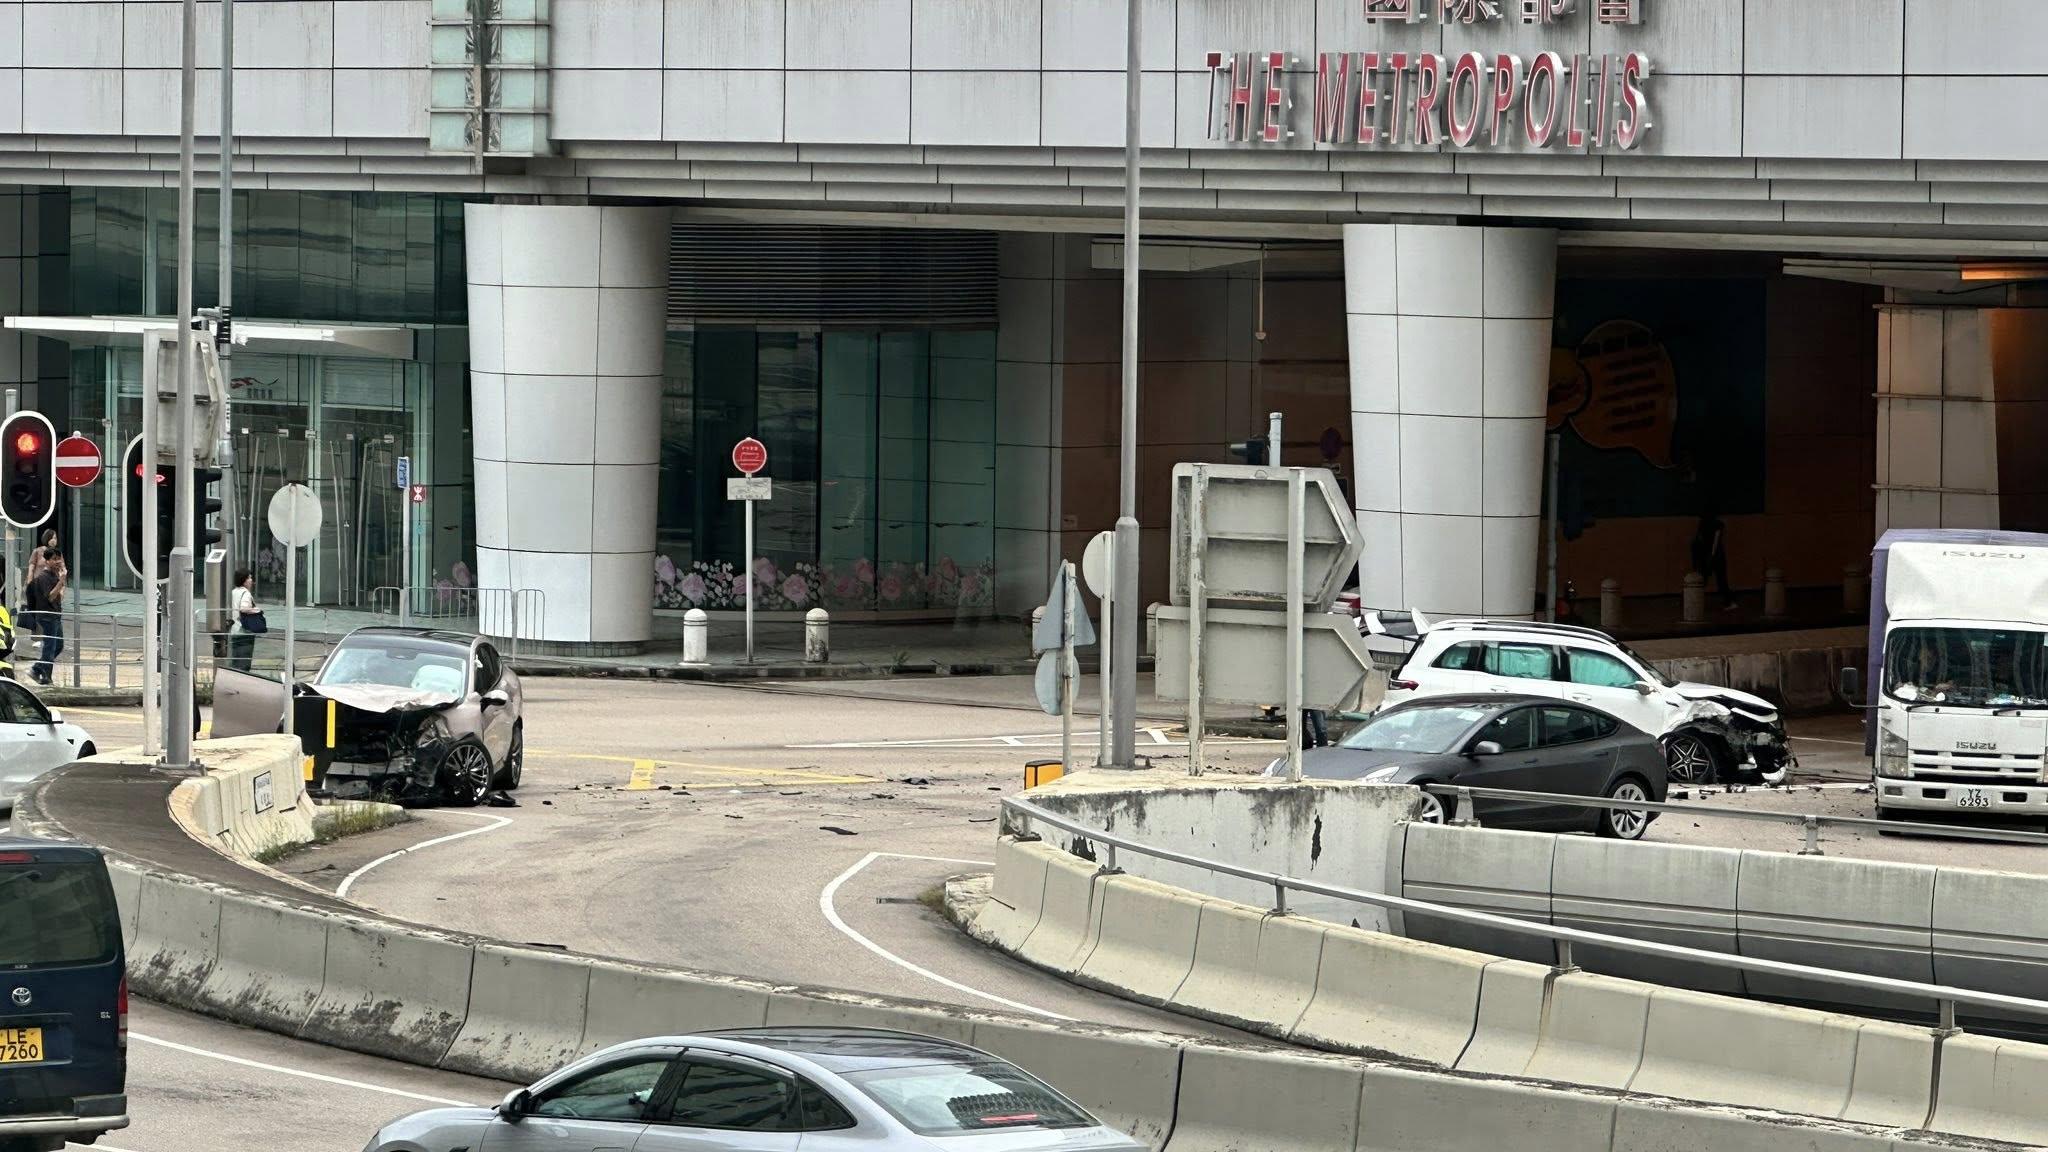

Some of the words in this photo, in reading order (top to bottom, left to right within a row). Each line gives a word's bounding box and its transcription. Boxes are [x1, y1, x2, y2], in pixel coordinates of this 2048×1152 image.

[1207, 51, 1291, 142] THE
[1314, 51, 1649, 150] METROPOLIS
[1942, 551, 2025, 560] ISUZU
[1956, 741, 1997, 751] ISUZU
[1968, 789, 1982, 798] YZ
[1959, 797, 1990, 808] 6293
[7, 1030, 28, 1045] LE
[0, 1044, 39, 1062] 7260
